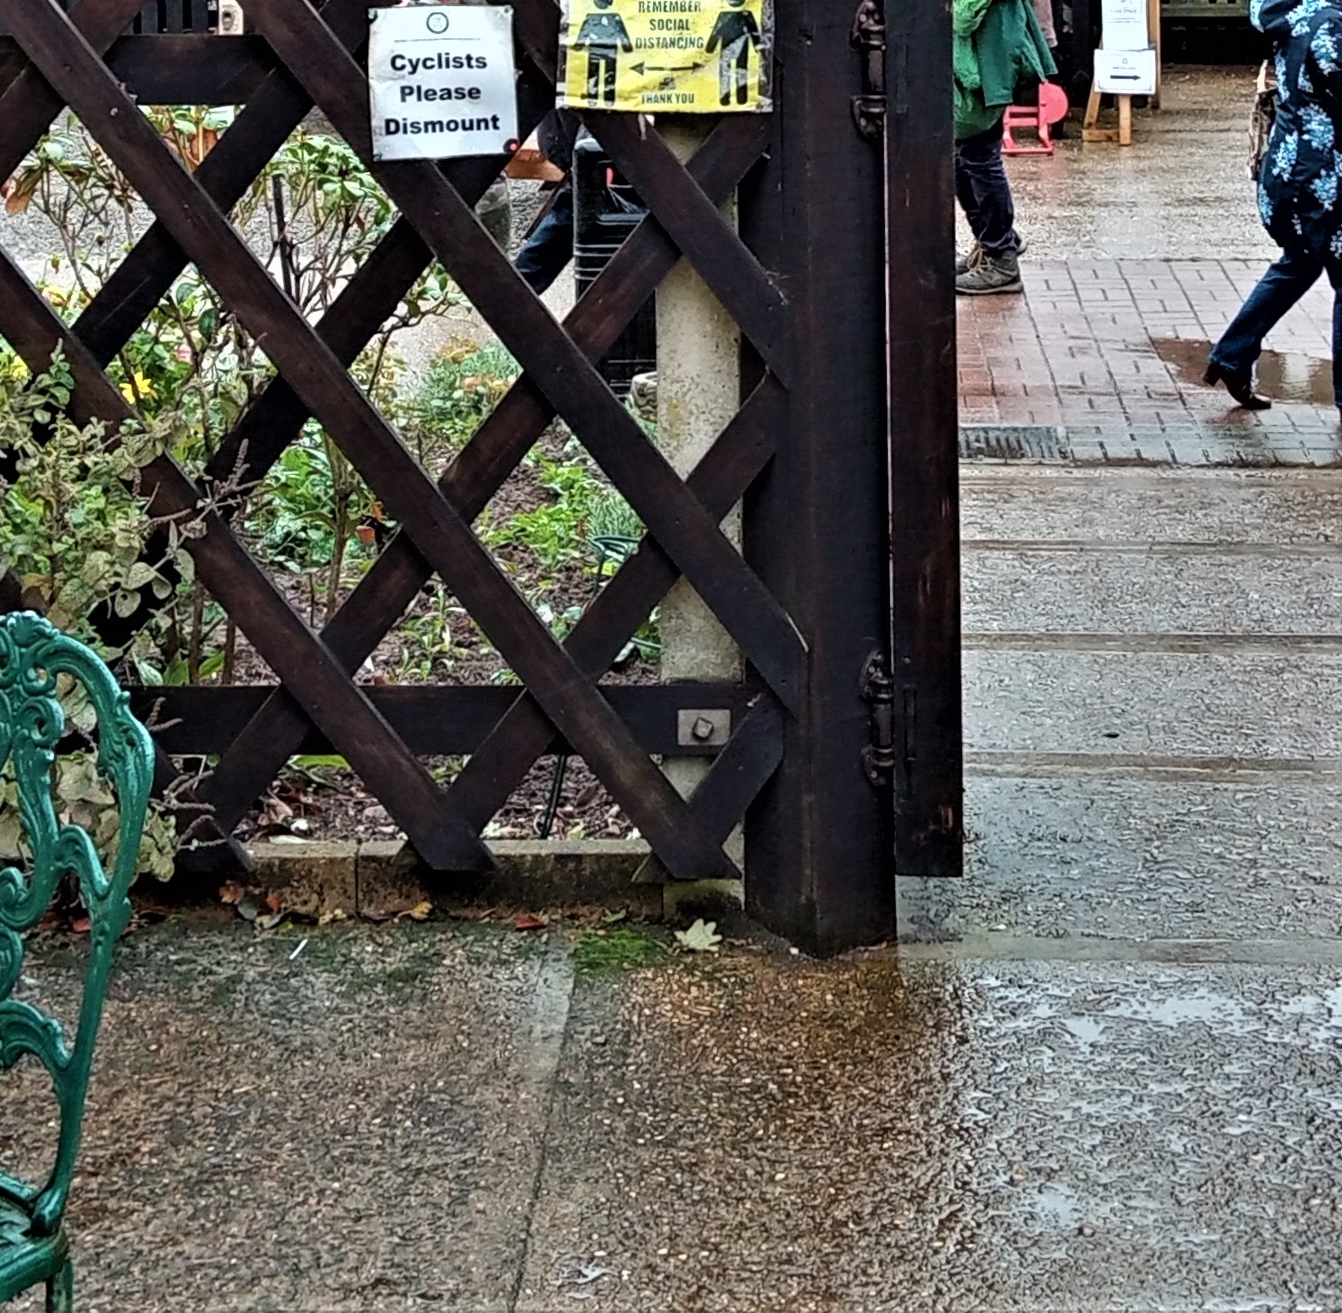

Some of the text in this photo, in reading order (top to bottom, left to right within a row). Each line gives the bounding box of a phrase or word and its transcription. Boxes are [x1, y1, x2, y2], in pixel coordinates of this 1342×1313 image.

[637, 0, 702, 13] REMEMBER
[649, 18, 691, 32] SOCIAL
[635, 36, 704, 50] DISTANCING
[390, 52, 488, 74] Cyclists
[400, 84, 482, 104] Please
[641, 93, 695, 105] THANK YOU
[384, 113, 501, 136] Dismount
